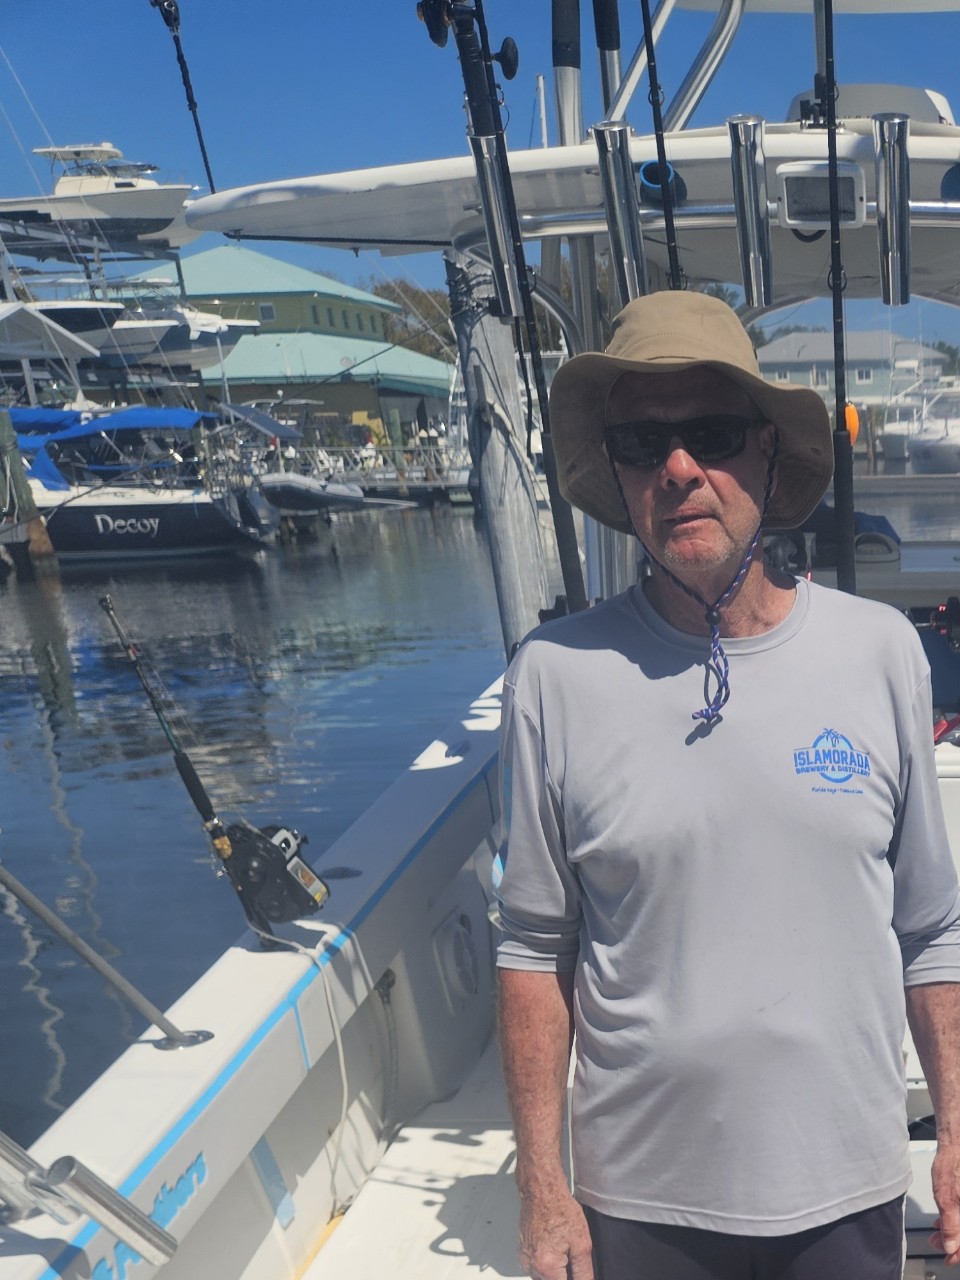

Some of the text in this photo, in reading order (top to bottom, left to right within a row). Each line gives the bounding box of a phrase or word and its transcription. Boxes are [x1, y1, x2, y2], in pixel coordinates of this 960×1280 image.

[94, 514, 160, 538] Decoy
[793, 749, 871, 772] ISLAMORADA
[796, 765, 829, 775] BREWERY
